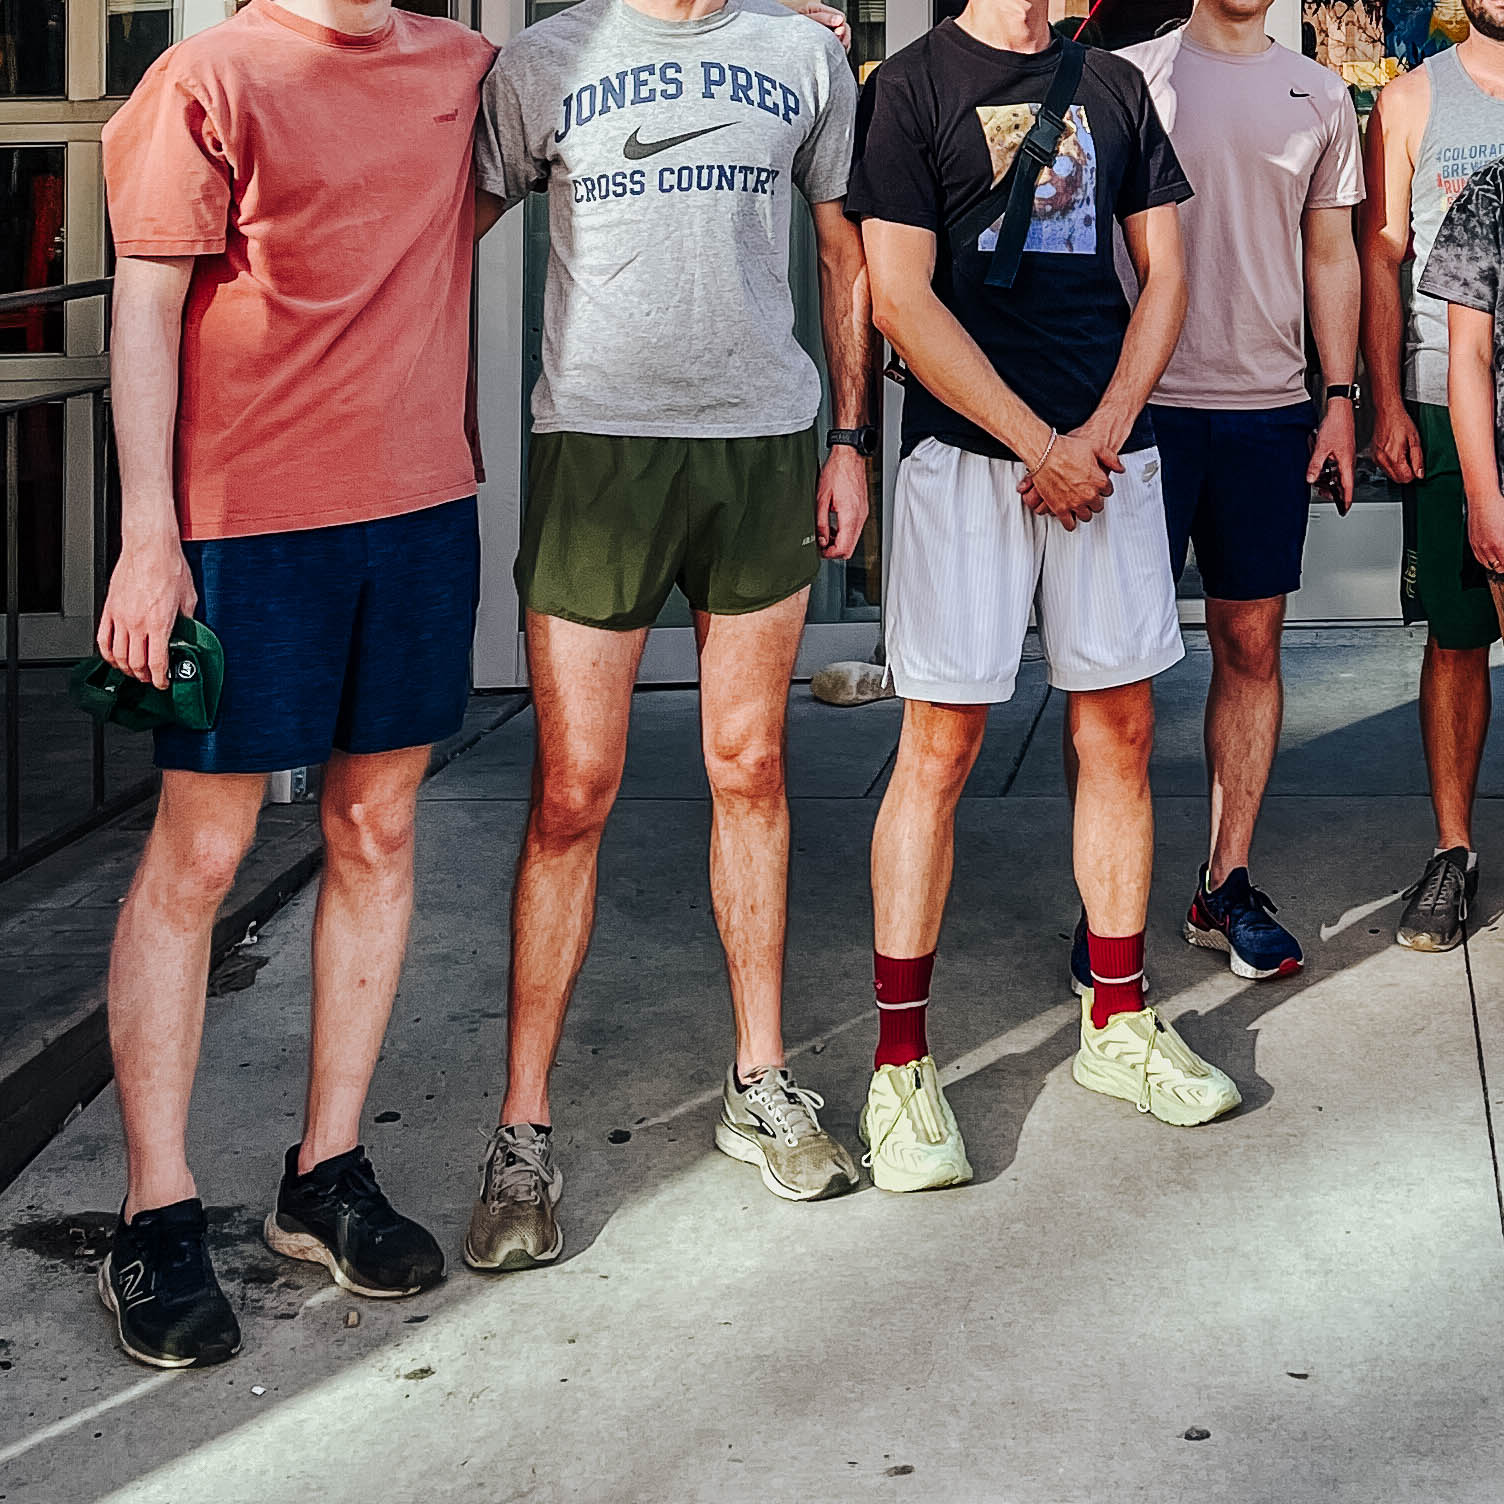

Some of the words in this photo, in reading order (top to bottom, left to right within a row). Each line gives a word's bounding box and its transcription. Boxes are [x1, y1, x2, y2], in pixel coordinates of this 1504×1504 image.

[554, 61, 684, 143] JONES
[701, 61, 801, 126] PREP
[572, 169, 646, 204] CROSS
[658, 164, 779, 196] COUNTRY
